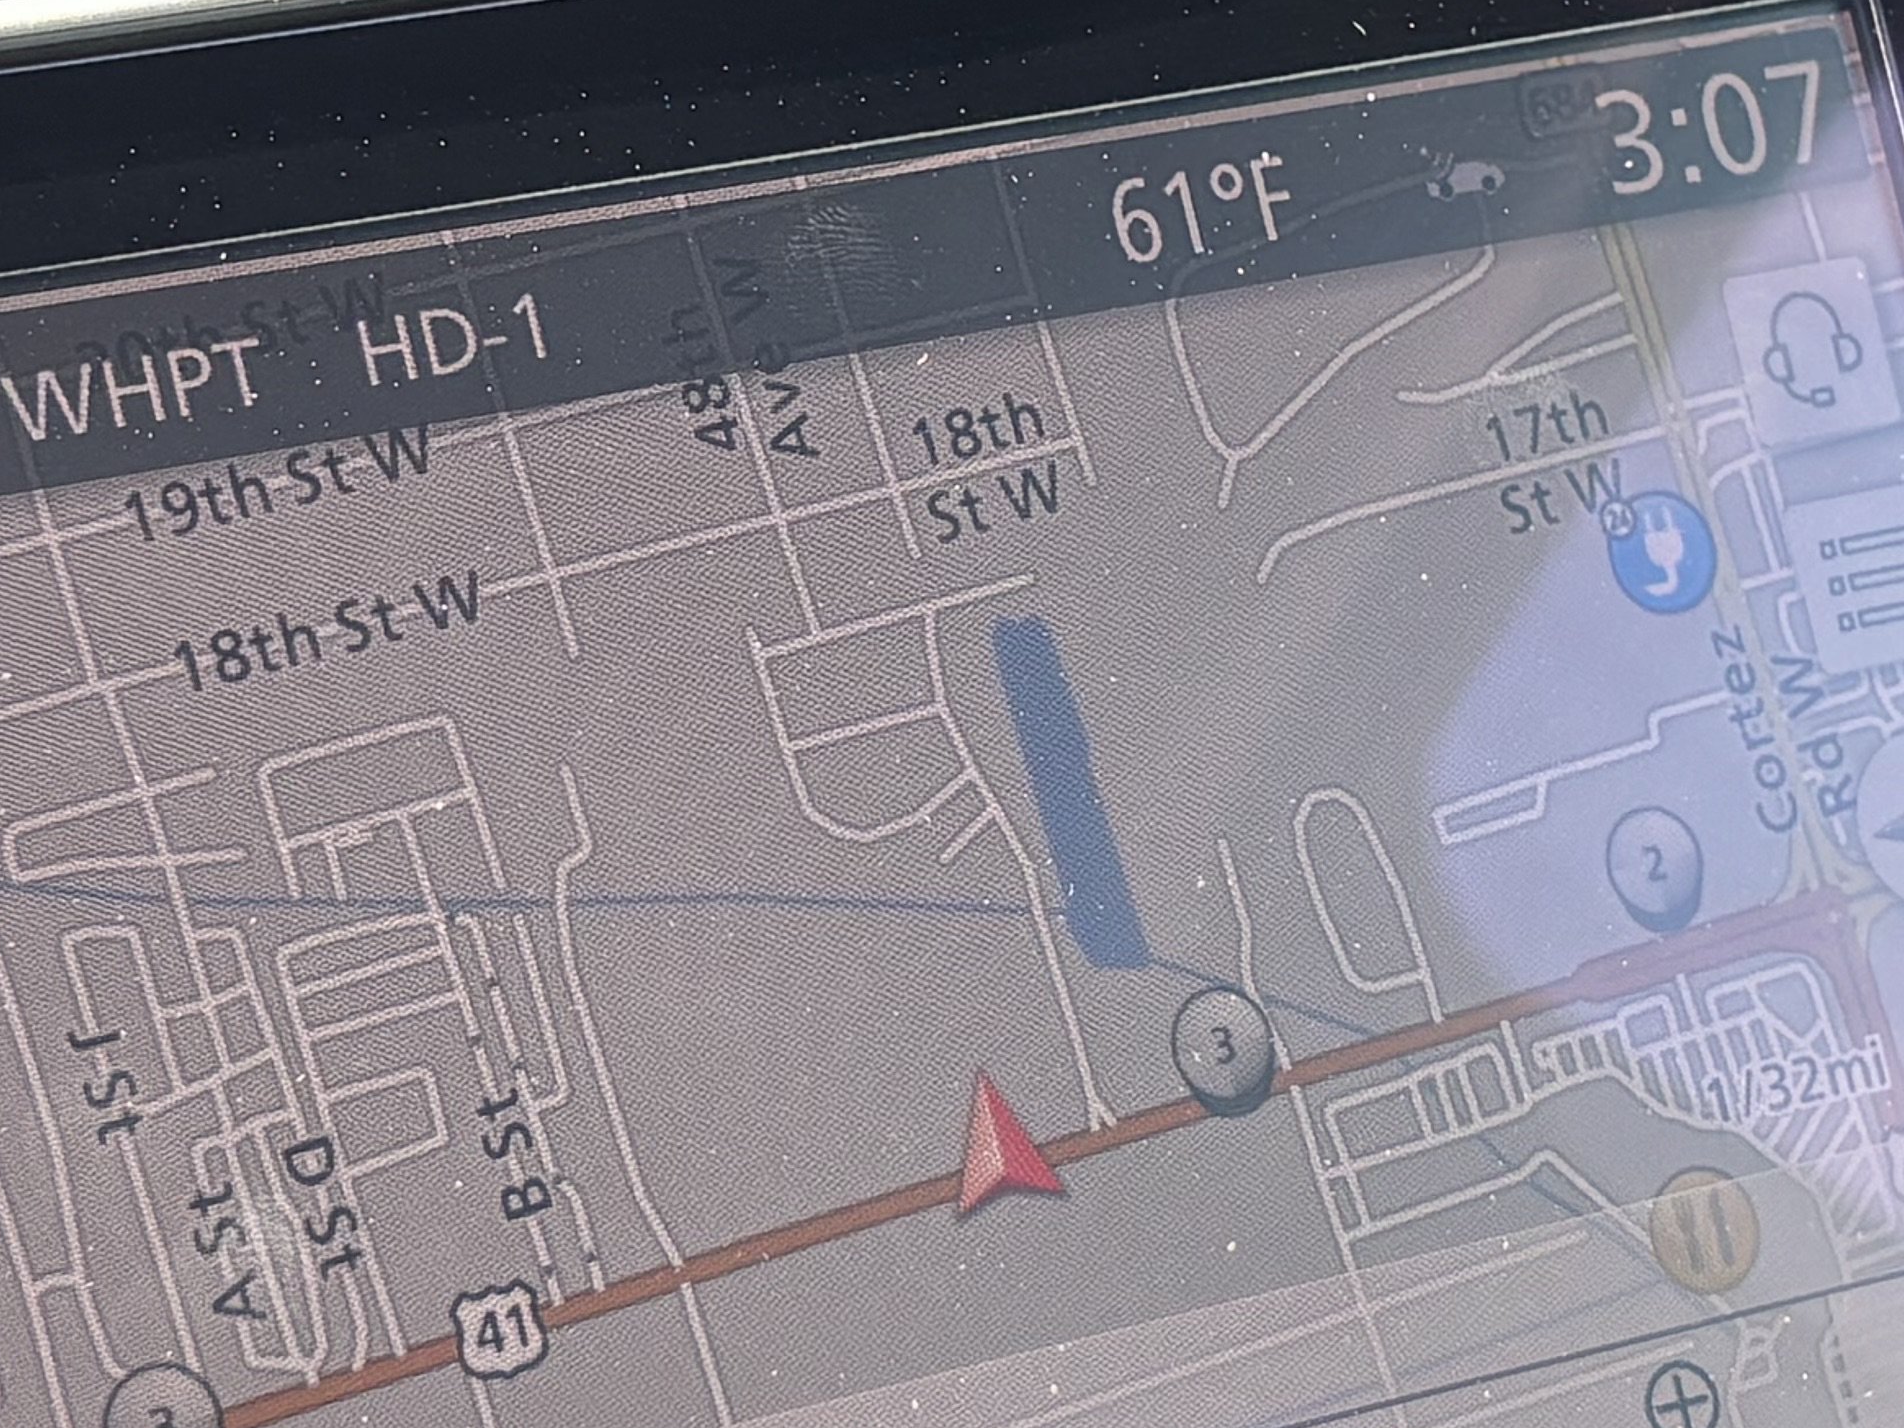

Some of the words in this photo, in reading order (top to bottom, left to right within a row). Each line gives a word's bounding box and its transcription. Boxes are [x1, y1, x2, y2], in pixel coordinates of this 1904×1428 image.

[1596, 60, 1822, 195] 3:07
[1112, 156, 1290, 264] 61°F
[240, 299, 309, 353] St
[0, 336, 260, 441] WHPT
[359, 293, 547, 386] HD-1
[662, 303, 738, 452] 48th
[754, 341, 822, 458] Ave
[912, 392, 1045, 465] 18th
[1486, 388, 1610, 462] 17th
[123, 463, 274, 542] 19th
[285, 445, 354, 508] St
[361, 424, 432, 485] W
[926, 487, 986, 545] St
[997, 461, 1061, 521] W
[1500, 480, 1561, 535] St
[1563, 457, 1622, 514] W
[172, 613, 323, 696] 18th
[333, 591, 402, 654] St
[404, 572, 484, 632] W
[1771, 652, 1827, 719] W
[1711, 625, 1796, 834] Cortez
[1800, 732, 1855, 819] Rd
[1640, 844, 1668, 883] 2
[1210, 1026, 1240, 1065] 3
[83, 1072, 143, 1145] St
[476, 1087, 534, 1161] St
[283, 1136, 335, 1186] D
[500, 1175, 553, 1222] B
[188, 1179, 245, 1256] St
[304, 1203, 364, 1283] St
[212, 1274, 267, 1320] A
[475, 1302, 534, 1354] 41
